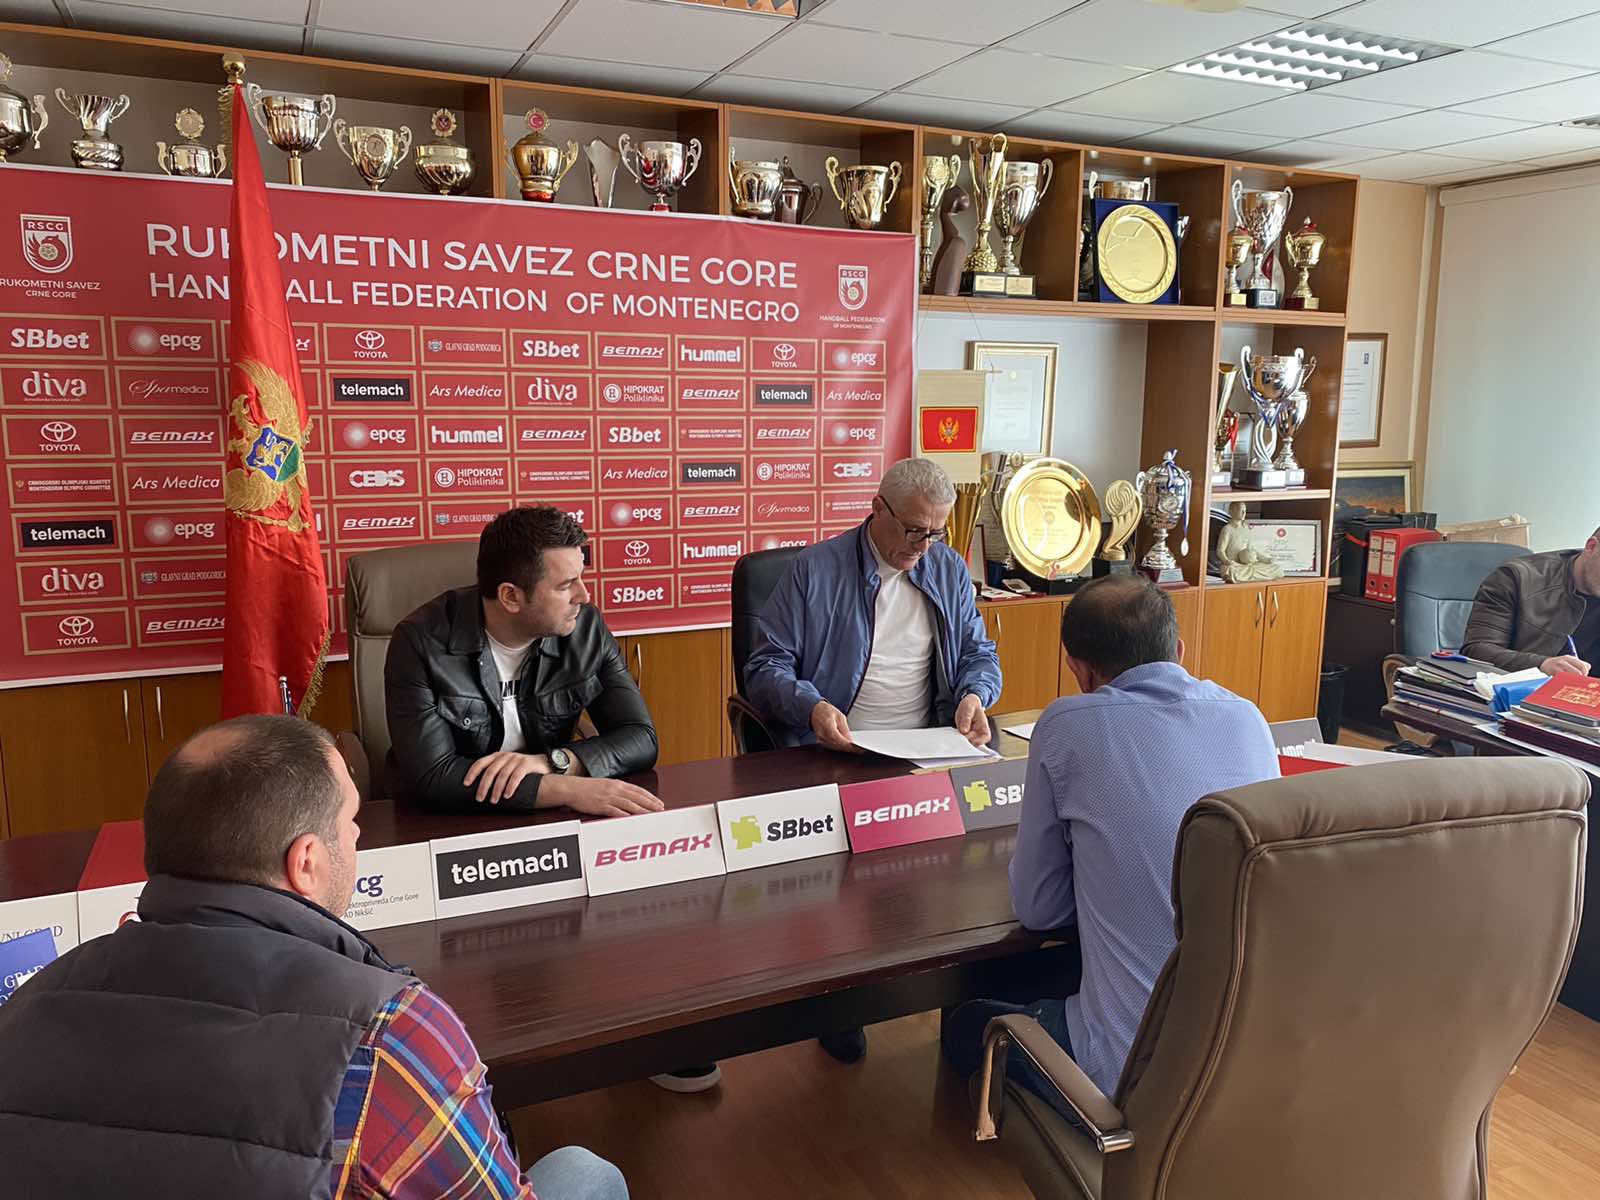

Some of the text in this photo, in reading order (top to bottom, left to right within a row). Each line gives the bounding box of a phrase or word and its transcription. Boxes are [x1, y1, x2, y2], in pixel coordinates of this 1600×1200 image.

[27, 221, 64, 231] RSCG
[146, 223, 798, 289] RUMETNI SAVEZ CRNE GORE
[841, 270, 865, 278] RSCG
[0, 278, 101, 290] RUKOMETNI SAVEZ
[25, 289, 77, 299] CRNE GORE
[149, 272, 800, 322] HANALL FEDERATION OF MONTENEGRO
[10, 327, 90, 349] SBbet
[159, 332, 202, 351] epcg
[353, 350, 388, 359] TOYOTA
[522, 340, 580, 358] SBbet
[602, 345, 665, 357] BEMAX
[681, 344, 741, 363] hummel
[771, 361, 797, 369] TOYOTA
[851, 352, 877, 366] epcg
[22, 370, 87, 398] diva
[340, 382, 404, 396] telemach
[527, 377, 578, 401] diva
[429, 385, 502, 398] Ars Medica
[623, 385, 665, 403] HIPOKRAT Poliklinika
[682, 388, 740, 399] BEMAX
[760, 389, 808, 400] telemach
[826, 391, 882, 401] Ars Medica
[130, 431, 215, 443] BEMAX
[369, 427, 406, 444] epcg
[431, 425, 503, 443] hummel
[521, 429, 587, 440] BEMAX
[608, 426, 662, 443] SBbet
[757, 427, 811, 438] BEMAX
[850, 426, 876, 440] epcg
[39, 443, 81, 452] TOYOTA
[603, 468, 668, 480] Ars Medica
[687, 466, 736, 478] telemach
[774, 463, 811, 471] HIPOKRAT
[132, 474, 220, 490] Ars Medica
[457, 468, 504, 487] HIPOKRAT Poliklinika
[632, 507, 663, 521] epcg
[683, 505, 741, 516] BEMAX
[174, 521, 216, 538] epcg
[342, 516, 416, 529] BEMAX
[30, 526, 106, 541] telemach
[683, 540, 742, 559] hummel
[623, 557, 652, 565] TOYOTA
[41, 567, 105, 593] diva
[612, 586, 664, 603] SBbet
[146, 617, 225, 632] BEMAX
[57, 636, 99, 646] TOYOTA
[994, 783, 1025, 806] SB
[854, 796, 951, 827] BEMAX
[766, 814, 834, 842] SBbet
[594, 832, 713, 868] BEMAX
[450, 848, 569, 885] telemach
[356, 875, 384, 898] cg
